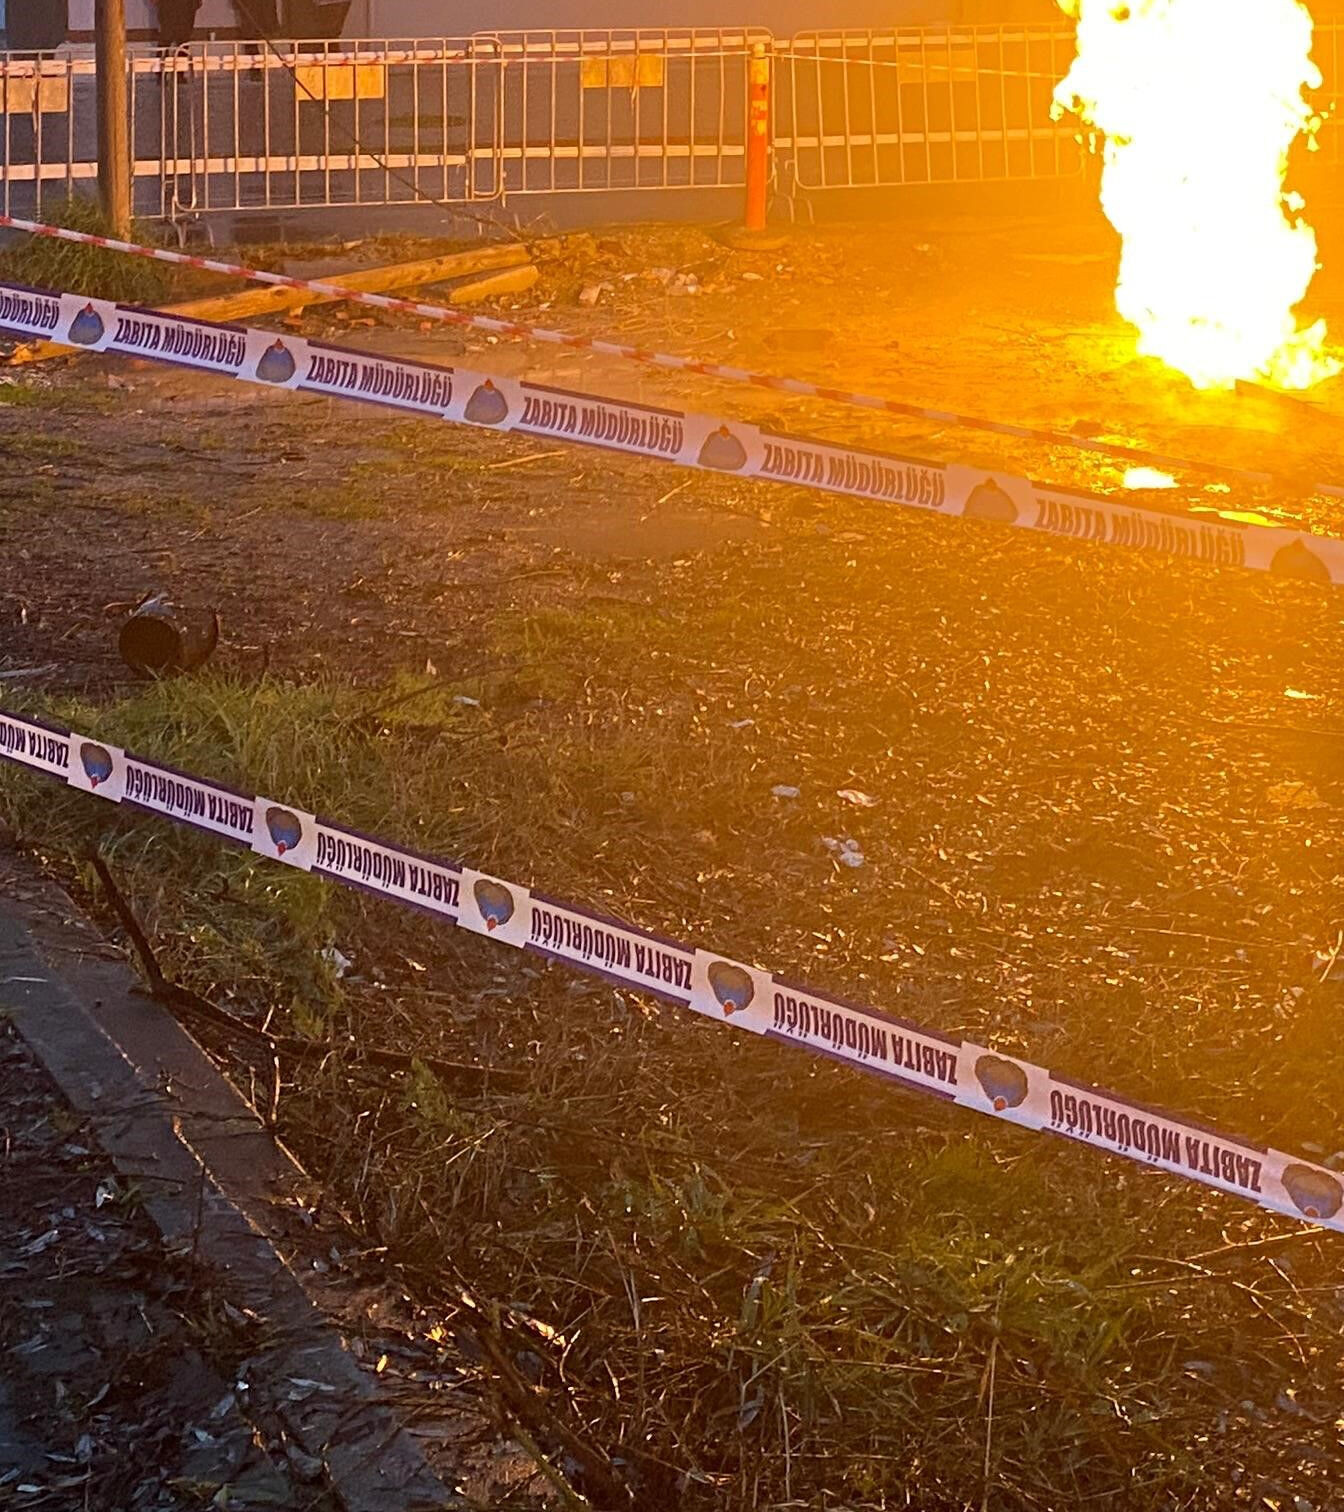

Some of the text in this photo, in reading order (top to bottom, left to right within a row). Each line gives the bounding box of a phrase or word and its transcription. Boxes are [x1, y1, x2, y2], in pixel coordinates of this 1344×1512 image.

[113, 317, 247, 368] ZABITA MÜDÜRLÜĞÜ
[306, 354, 453, 408] ZABITA MÜDÜRLÜĞÜ
[519, 396, 685, 455] ZABITA MÜDÜRLÜĞÜ
[760, 443, 946, 508] ZABITA MÜDÜRLÜĞÜ
[1033, 499, 1106, 540] ZABITA
[28, 729, 69, 768] ZABITA
[125, 764, 254, 833] ZABITA MÜDÜRLÜĞÜ
[316, 831, 460, 907] ZABITA MÜDÜRLÜĞÜ
[530, 906, 693, 990] ZABITA MÜDÜRLÜĞÜ
[773, 991, 958, 1084] ZABITA MÜDÜRLÜĞÜ
[1050, 1089, 1262, 1194] ZABITA MÜDÜRLÜĞÜ
